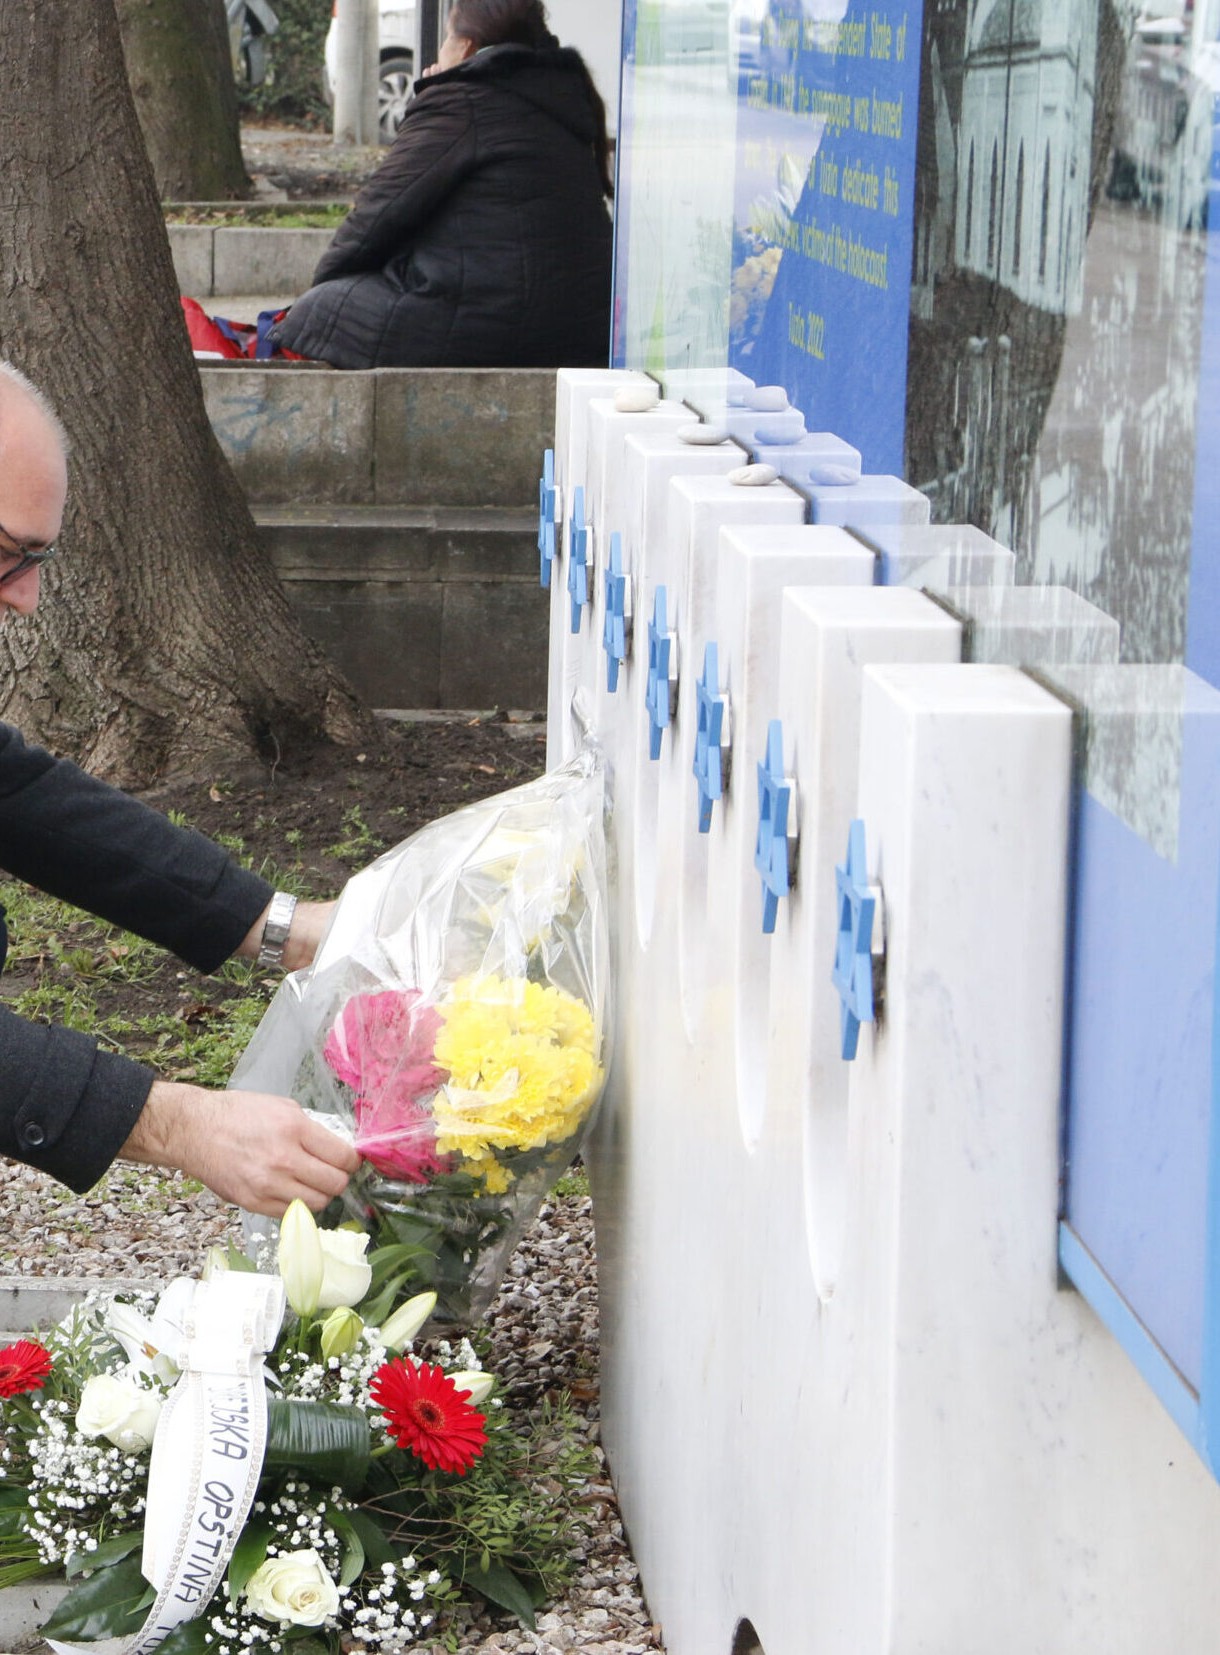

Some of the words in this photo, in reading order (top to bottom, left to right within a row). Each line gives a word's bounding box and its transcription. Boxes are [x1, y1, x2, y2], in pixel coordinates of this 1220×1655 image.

[870, 12, 892, 60] State
[896, 12, 908, 61] of
[854, 97, 869, 132] was
[872, 87, 903, 139] burned
[842, 155, 879, 210] dedicate
[884, 165, 899, 217] this
